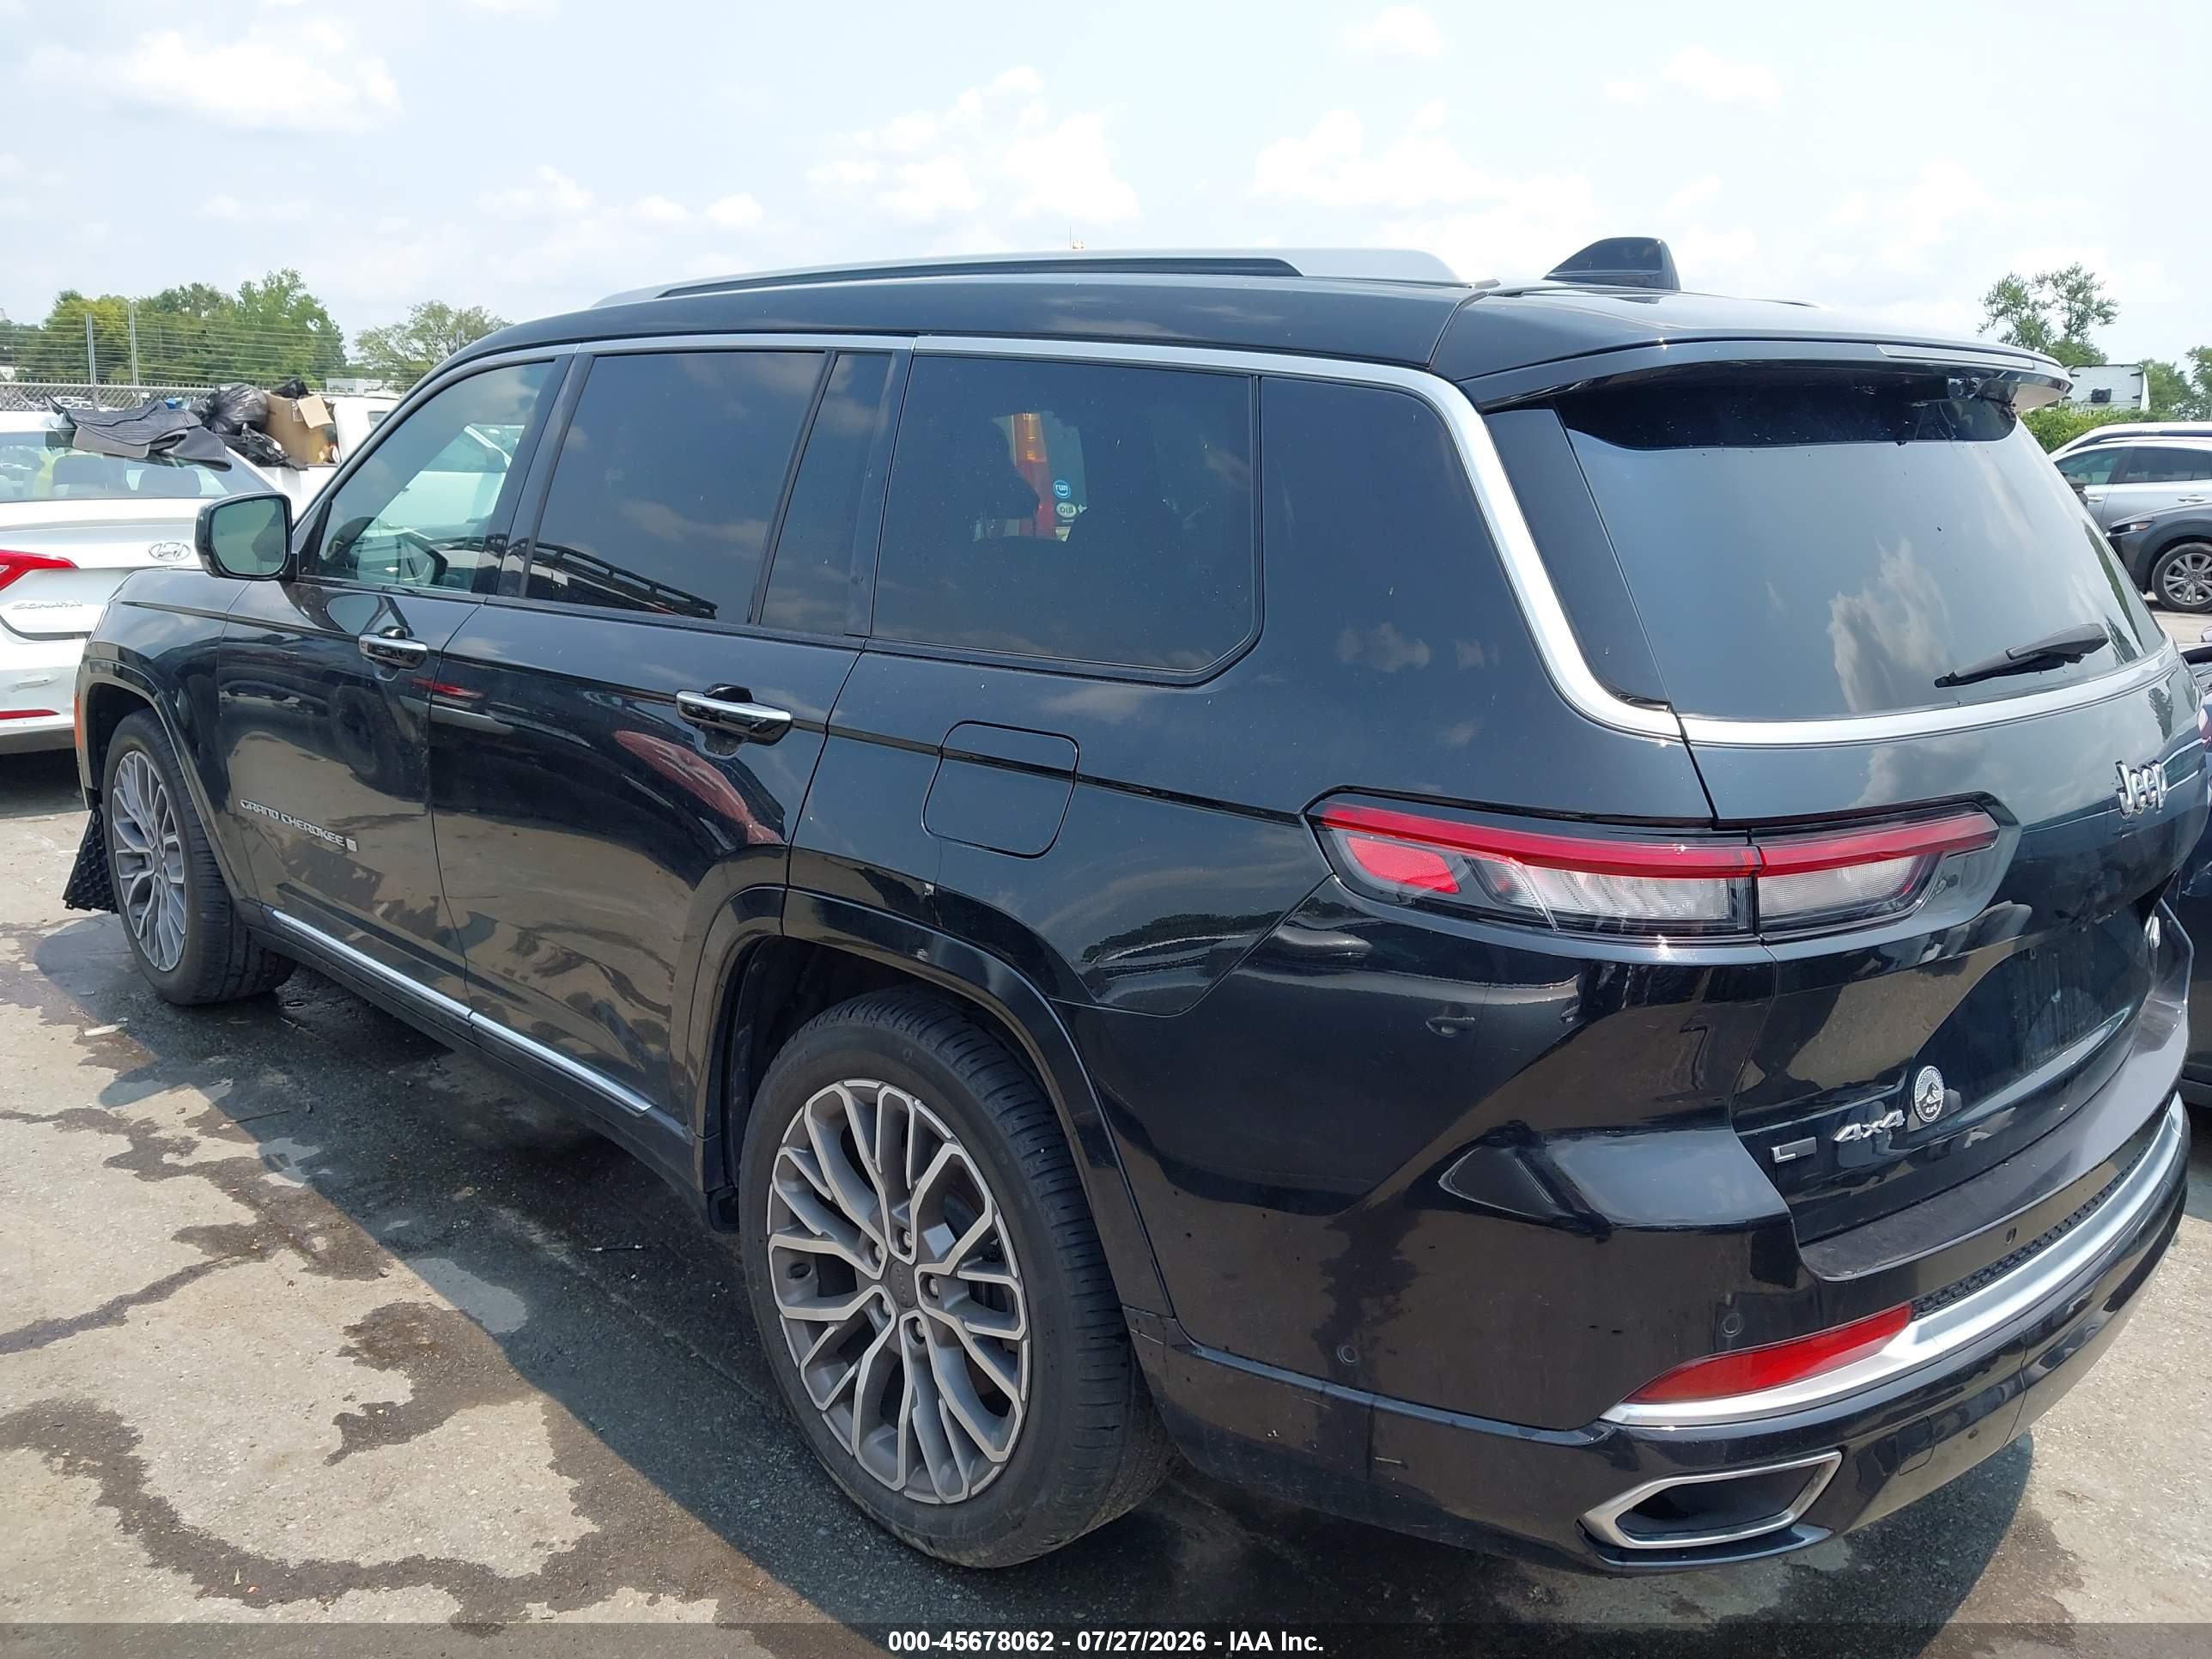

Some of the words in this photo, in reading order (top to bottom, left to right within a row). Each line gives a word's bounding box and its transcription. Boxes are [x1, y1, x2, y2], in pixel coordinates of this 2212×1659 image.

[2116, 763, 2167, 815] Jeep
[240, 799, 279, 820] GRAND
[280, 812, 345, 847] CHEROKEE
[1833, 1109, 1905, 1143] 4x4
